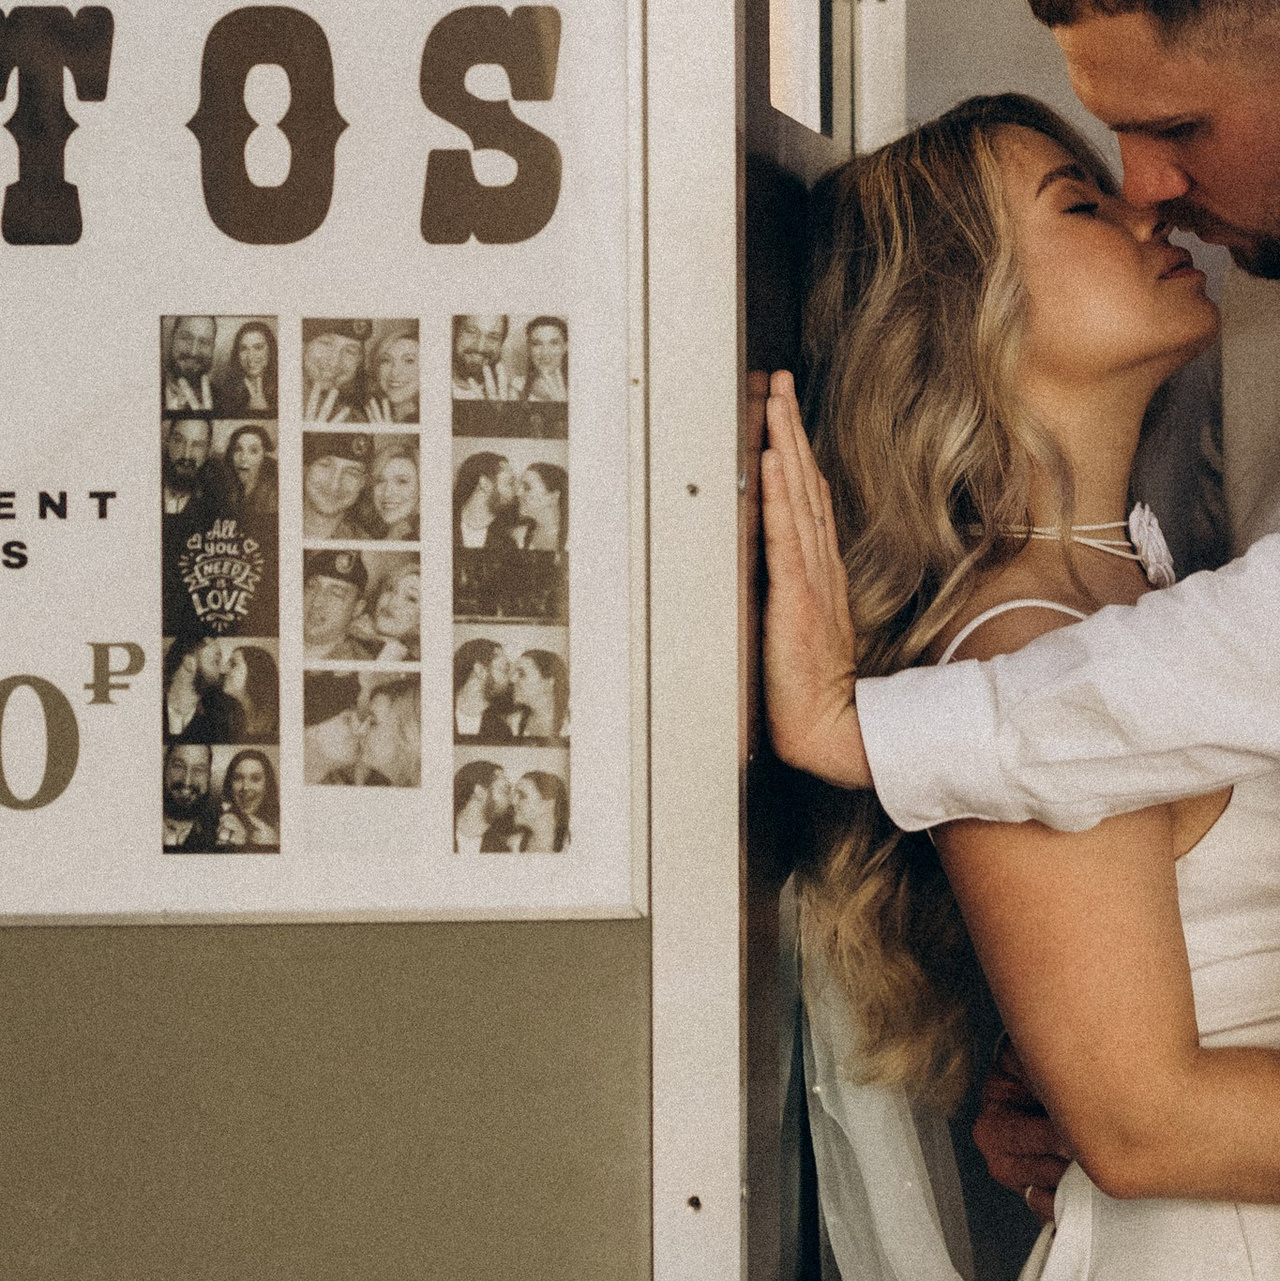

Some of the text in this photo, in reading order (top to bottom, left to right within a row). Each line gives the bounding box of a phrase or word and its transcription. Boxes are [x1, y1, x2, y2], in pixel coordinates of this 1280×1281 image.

[0, 5, 563, 246] TOS
[195, 541, 240, 562] you
[191, 590, 254, 615] LOVE
